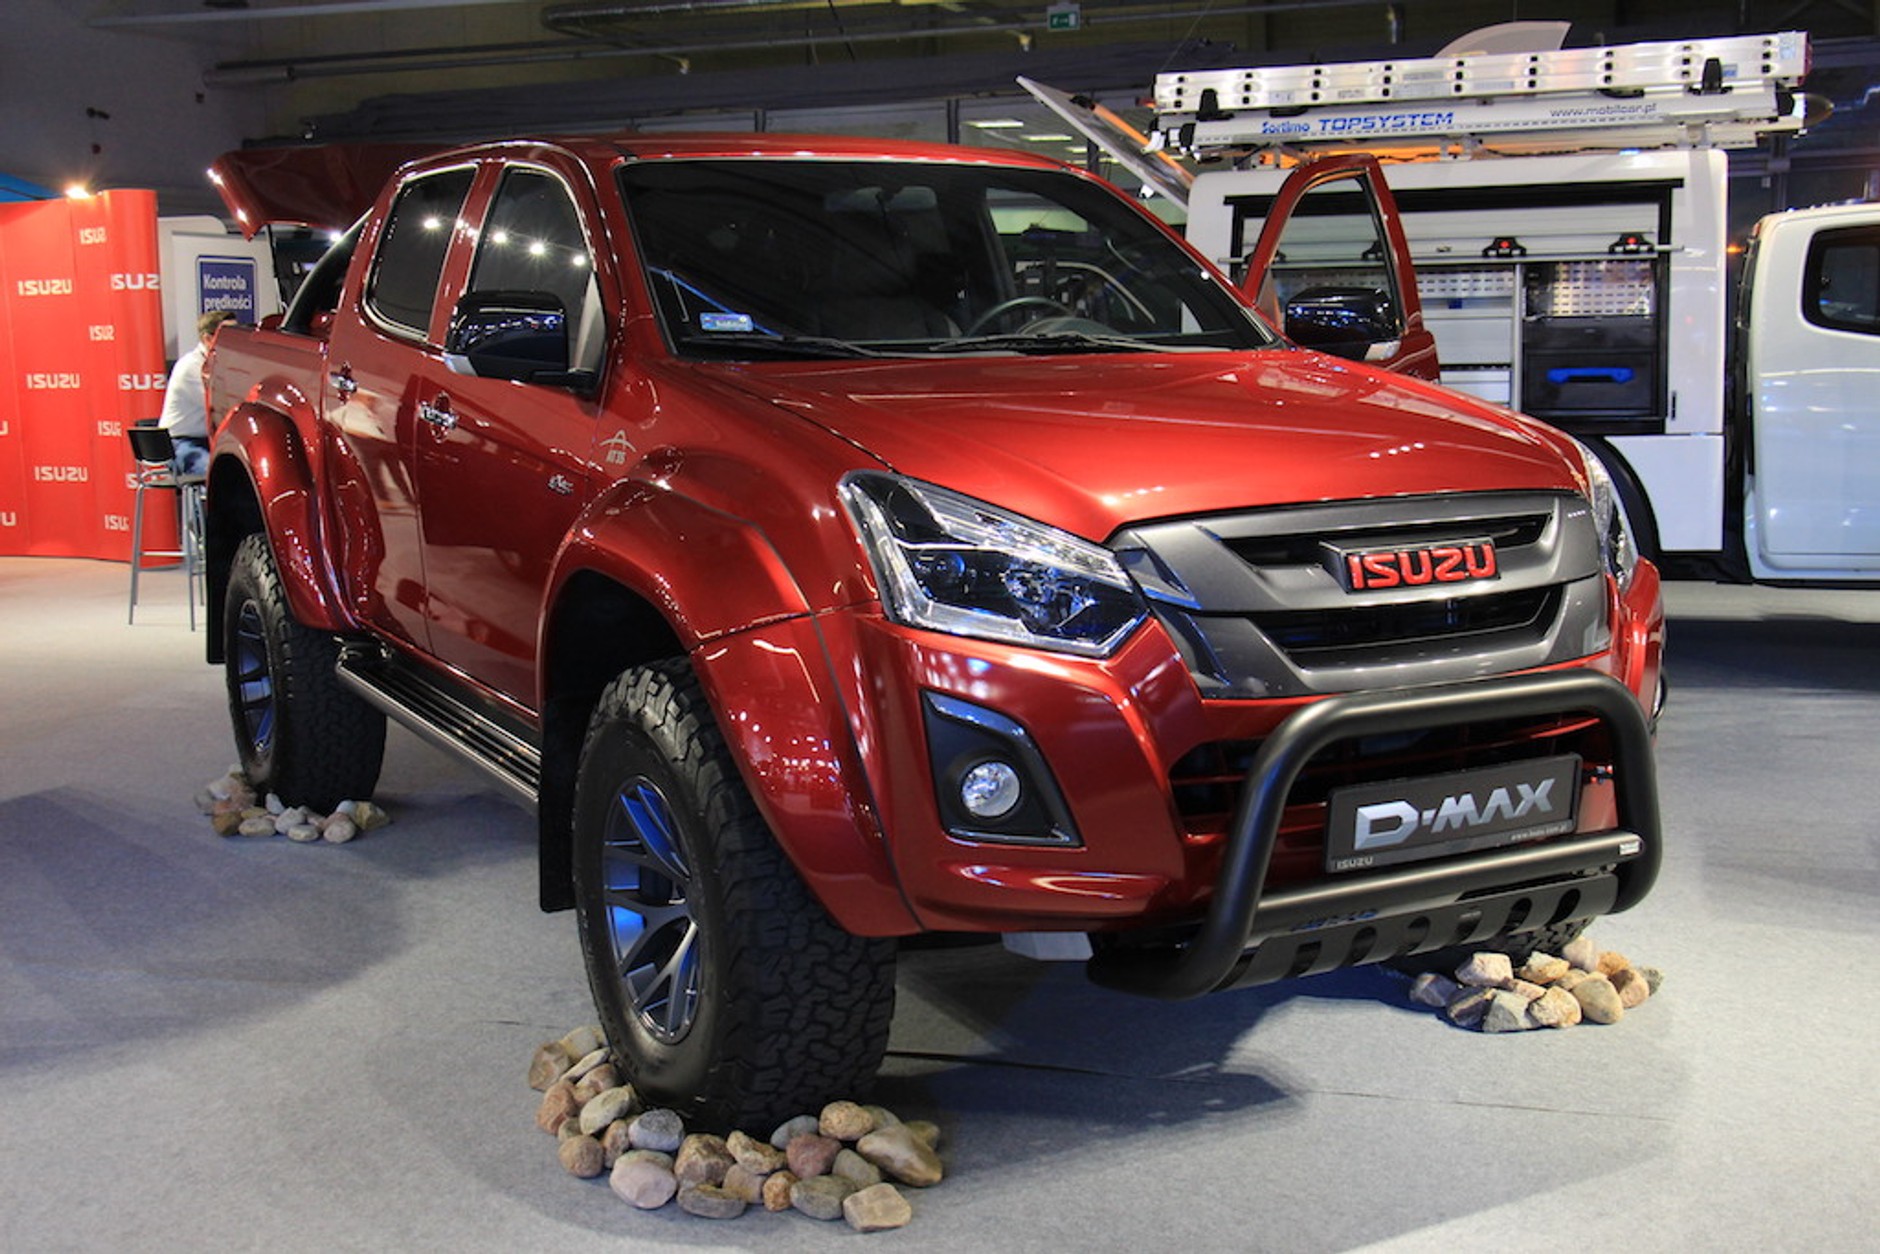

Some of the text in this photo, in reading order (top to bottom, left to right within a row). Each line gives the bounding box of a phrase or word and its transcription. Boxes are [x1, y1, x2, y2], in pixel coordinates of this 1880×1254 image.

[1262, 112, 1455, 134] Sortimo TOPSYSTEM
[17, 279, 73, 296] ISUZU
[203, 273, 248, 290] Kontrola
[26, 373, 81, 389] ISUZU
[34, 466, 88, 482] ISUZU
[1347, 543, 1496, 590] ISUZU
[1354, 777, 1556, 851] D-MAX
[1336, 855, 1374, 870] ISUZU
